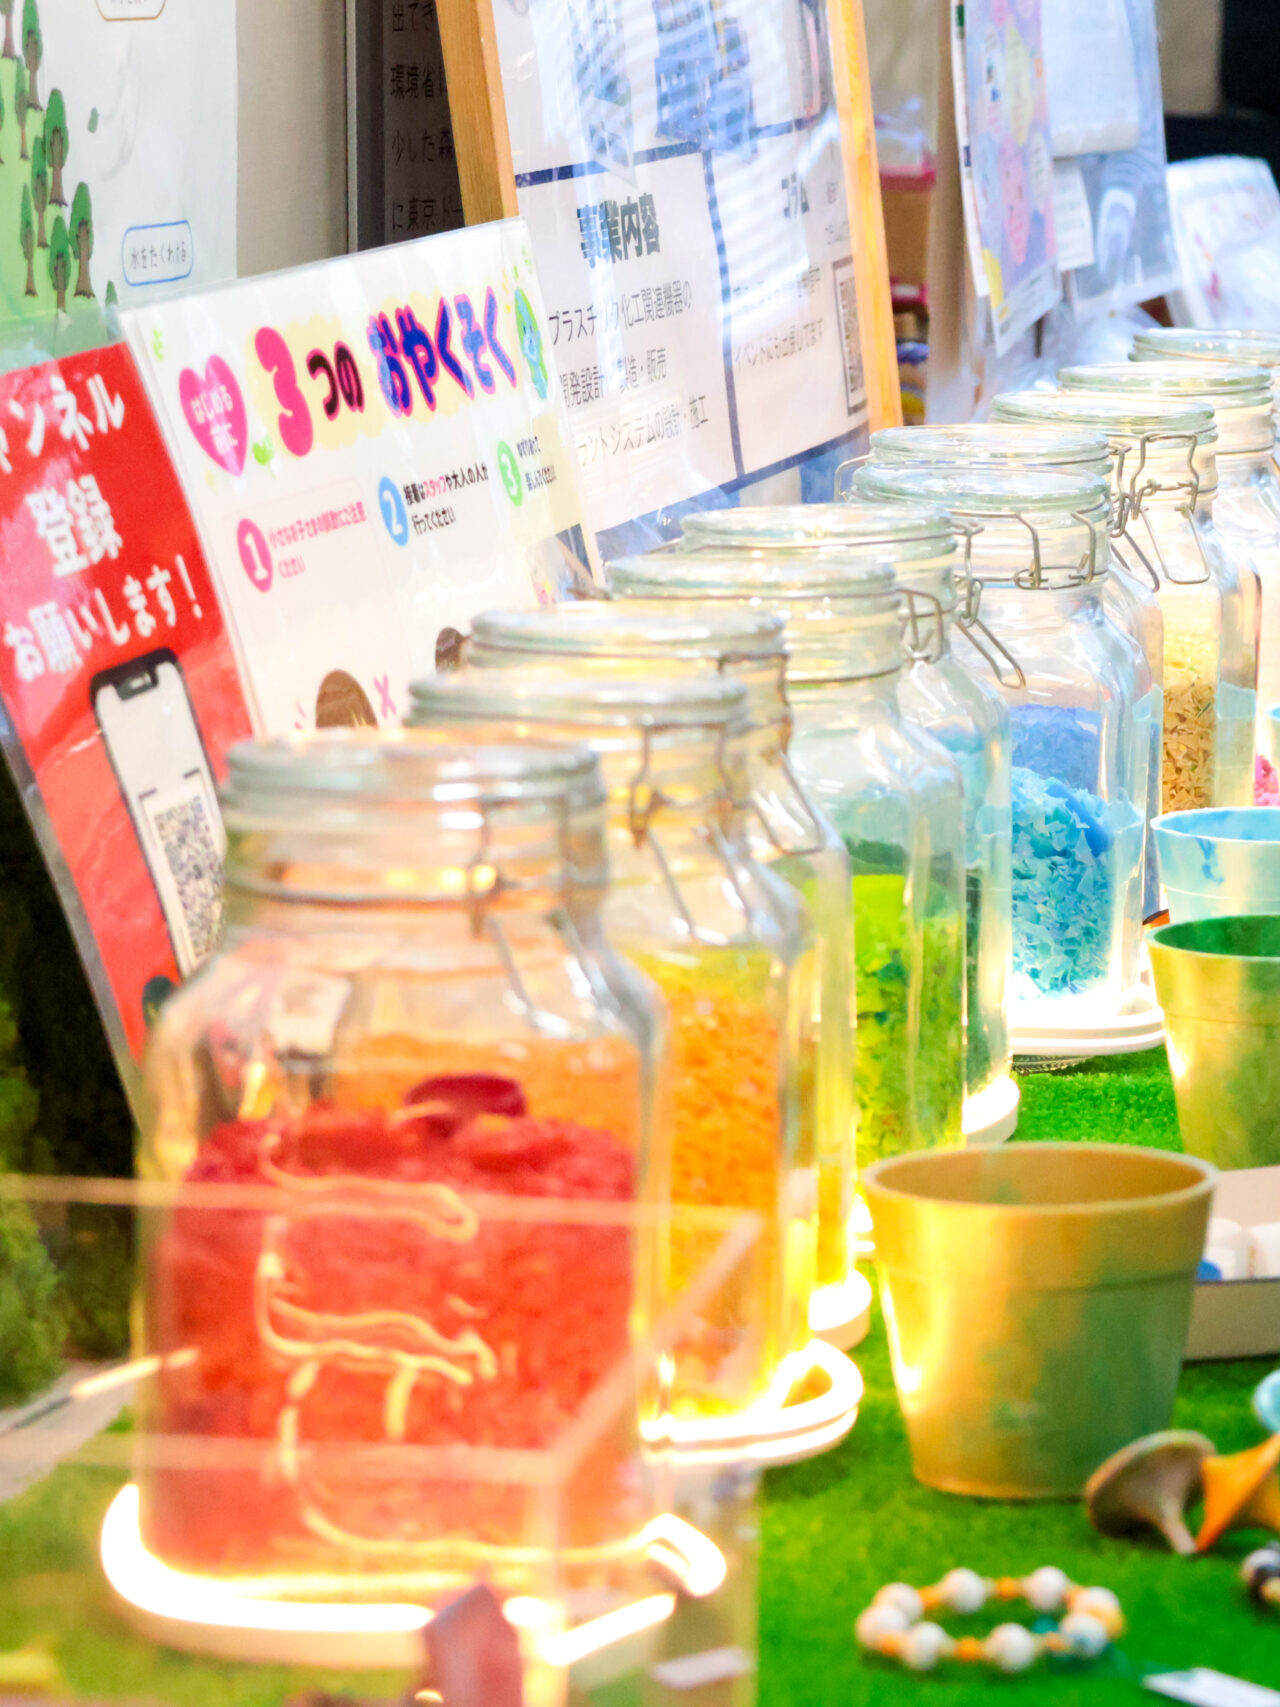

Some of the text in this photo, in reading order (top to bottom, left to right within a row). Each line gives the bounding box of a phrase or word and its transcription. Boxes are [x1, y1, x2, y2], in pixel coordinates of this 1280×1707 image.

[577, 193, 660, 268] 事業内容
[560, 348, 667, 408] 開発設計製造・販売
[25, 475, 123, 576] 登録
[411, 506, 457, 536] 行ってください
[5, 554, 202, 681] お願いします!
